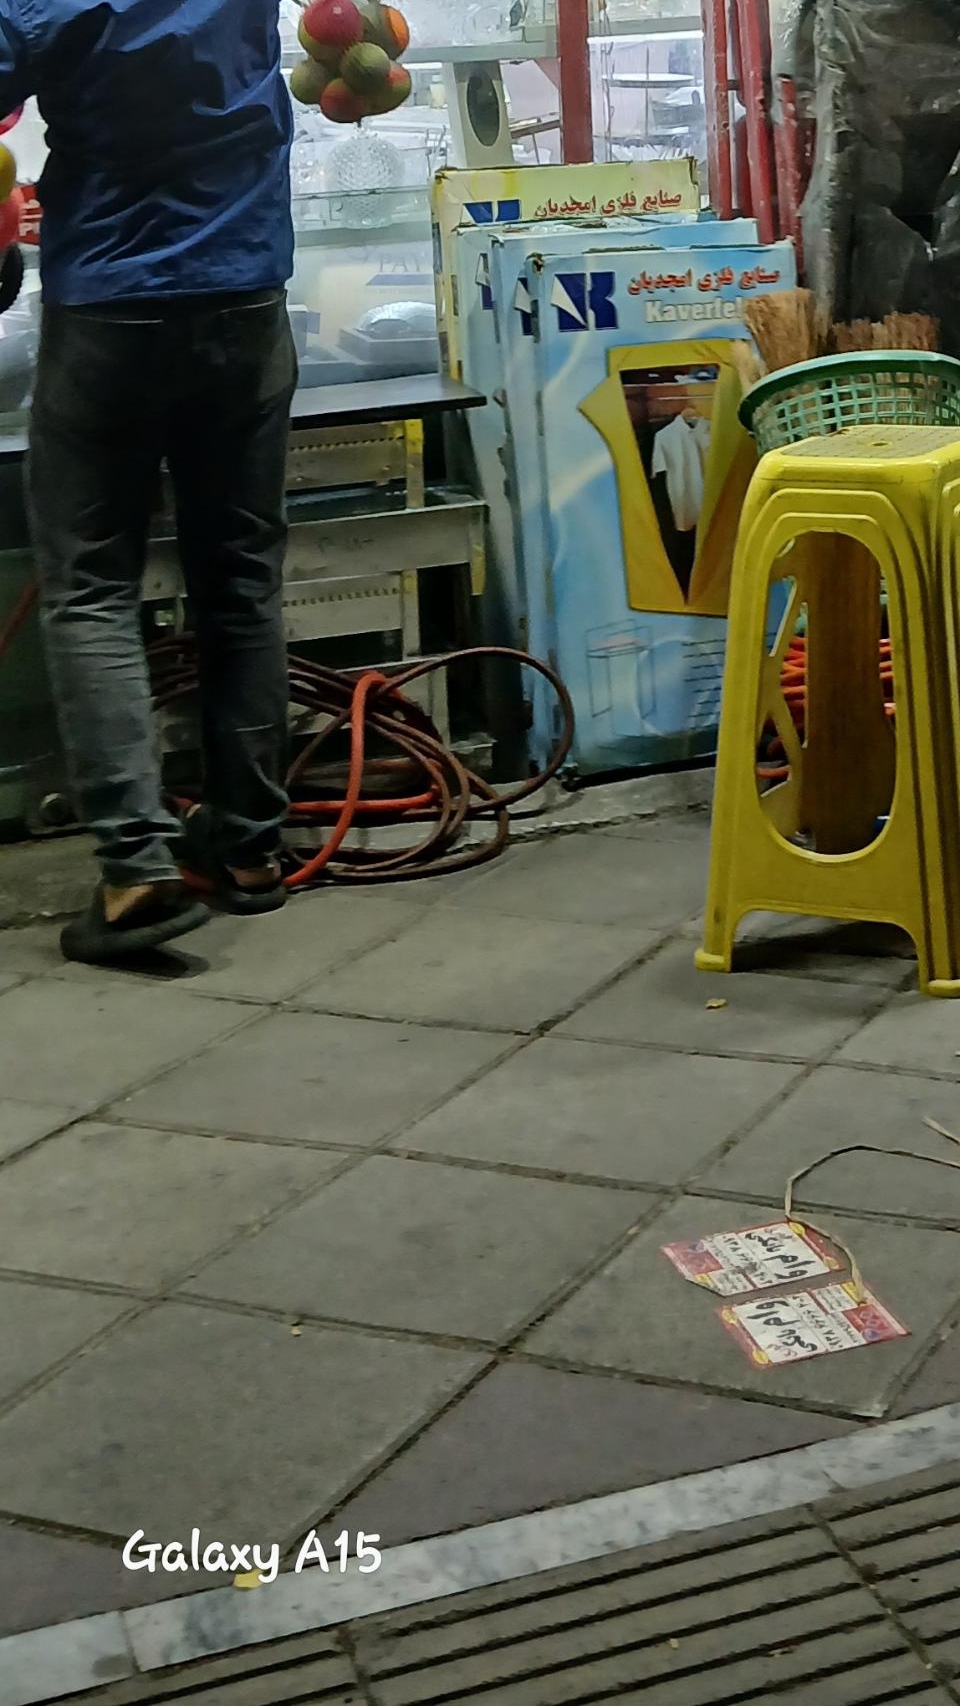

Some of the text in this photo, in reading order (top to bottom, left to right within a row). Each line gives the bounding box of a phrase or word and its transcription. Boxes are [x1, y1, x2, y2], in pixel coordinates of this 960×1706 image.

[600, 191, 637, 215] فلزی
[640, 189, 682, 213] صنایع
[627, 265, 781, 295] صنایع فلزی امجدیان
[761, 1254, 817, 1279] وام
[746, 1300, 801, 1326] وام
